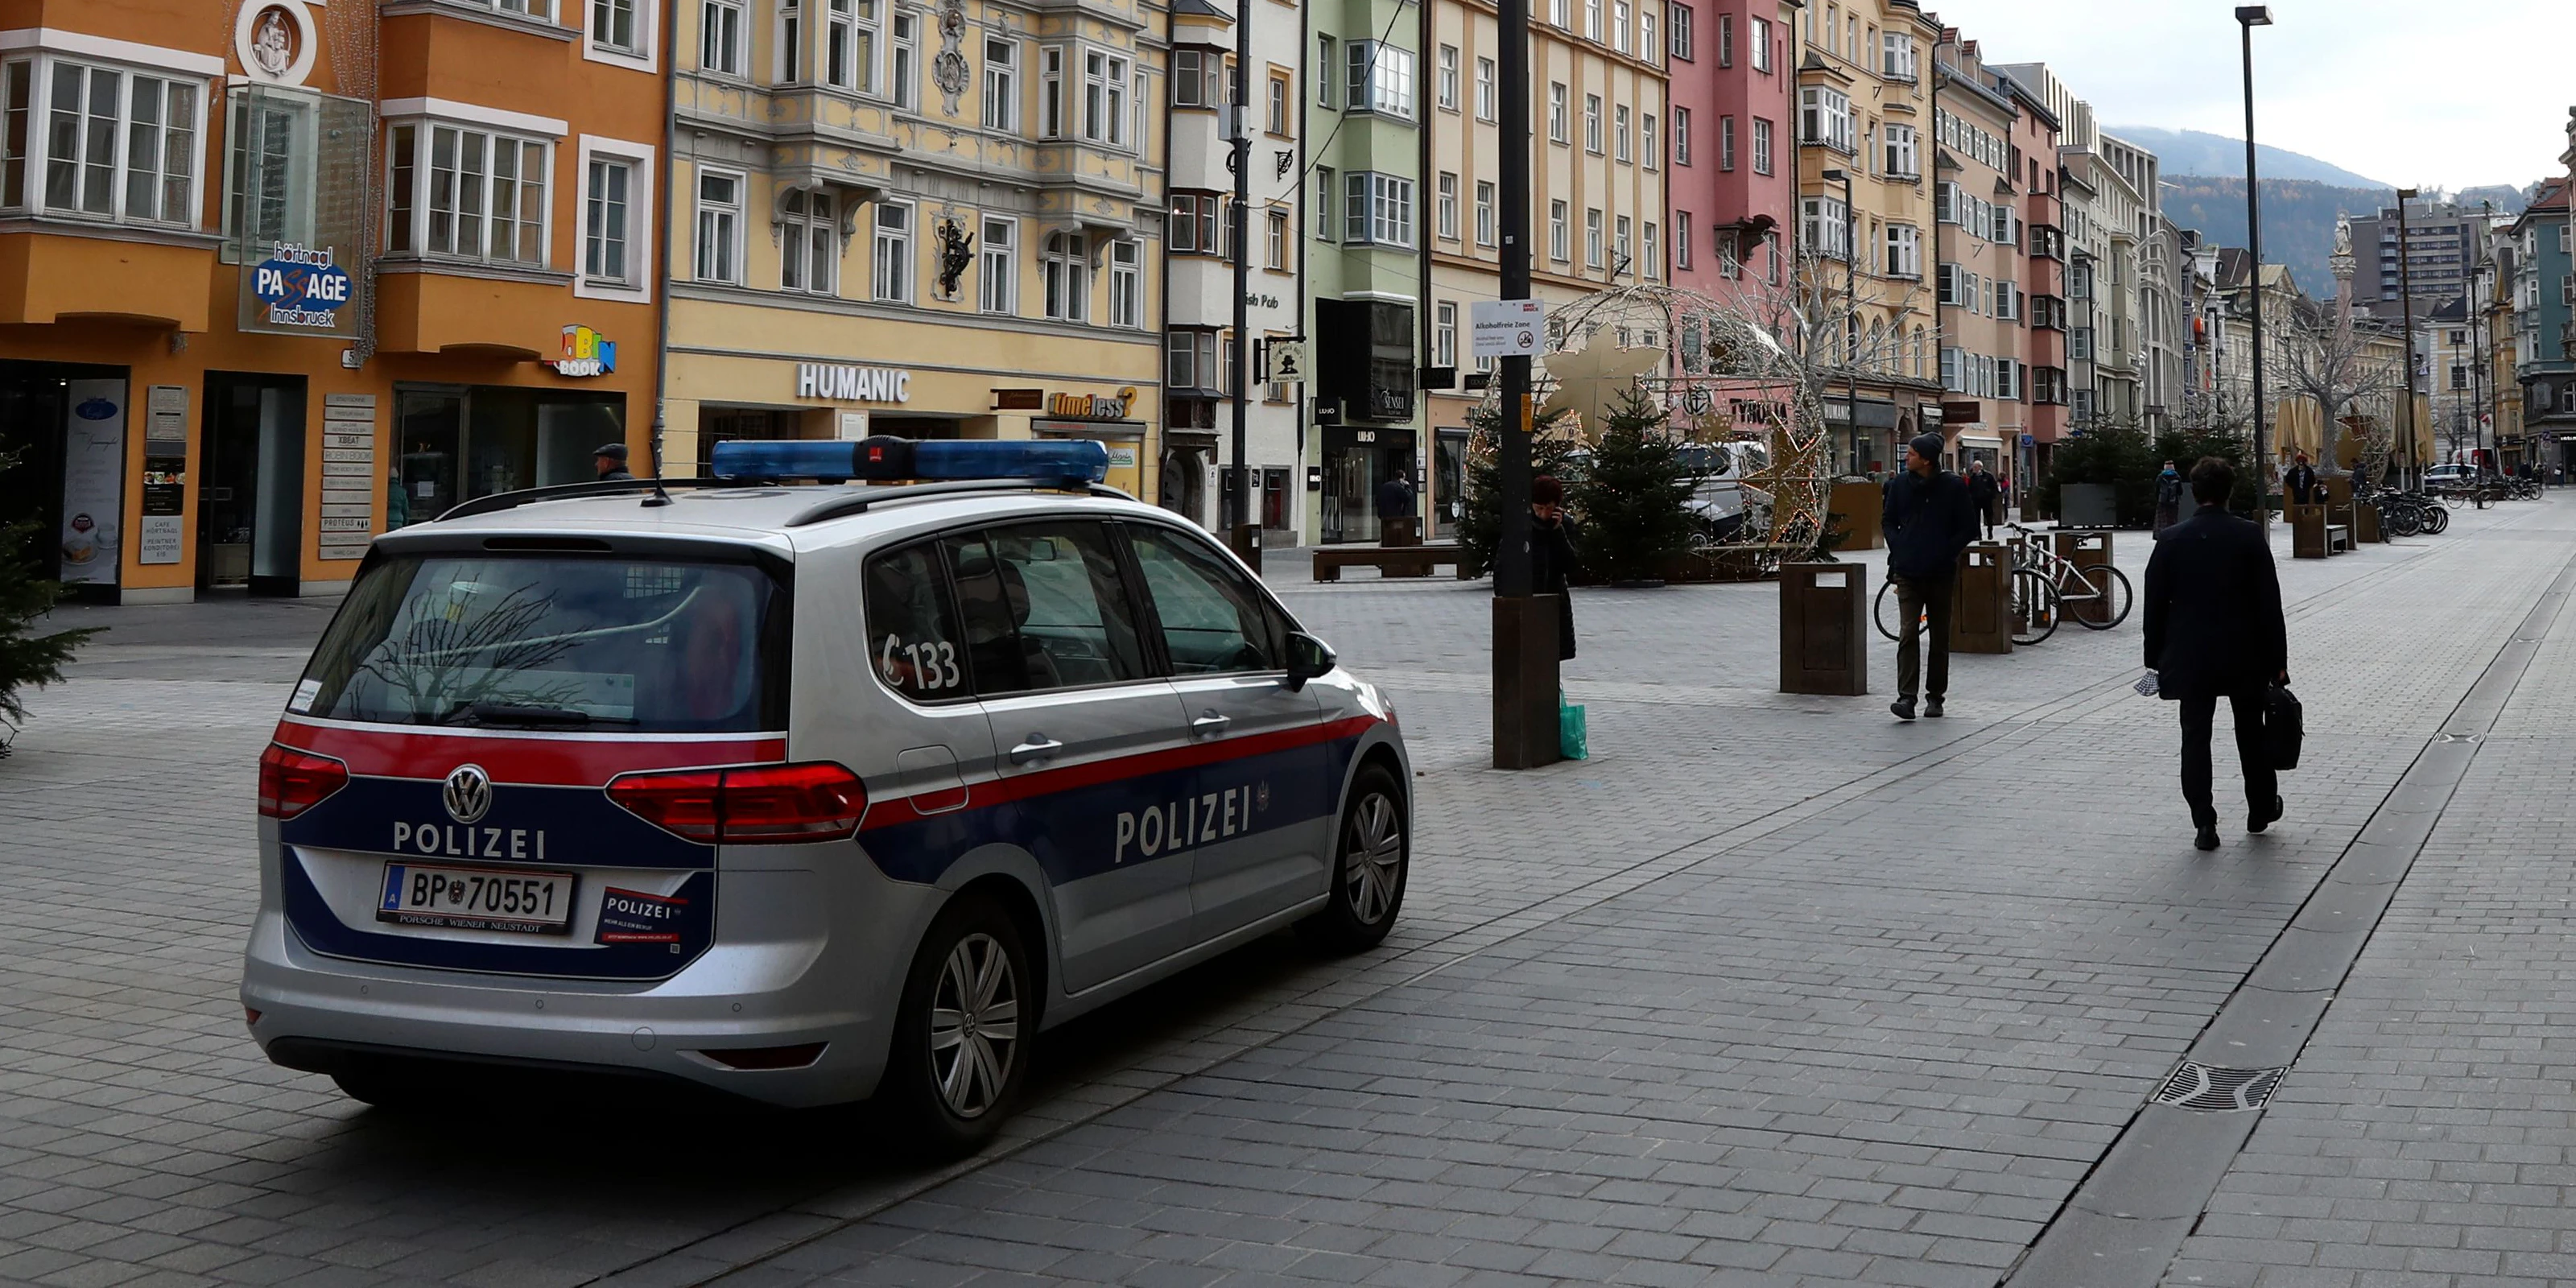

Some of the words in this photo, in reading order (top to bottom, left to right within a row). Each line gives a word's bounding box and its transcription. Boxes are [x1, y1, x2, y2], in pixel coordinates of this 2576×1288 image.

[275, 240, 332, 270] hörtnagl
[270, 303, 335, 328] Innsbruck
[1261, 295, 1279, 309] Pub
[559, 360, 601, 377] BOOK
[797, 363, 910, 402] HUMANIC
[324, 518, 354, 526] PROTEUS
[904, 641, 960, 690] 133
[1115, 785, 1251, 864] POLIZEI
[394, 820, 545, 860] POLIZEI
[387, 894, 397, 903] A
[411, 873, 448, 907] BP
[468, 877, 555, 916] 70551
[607, 898, 671, 919] POLIZEI
[399, 915, 444, 926] PORSCHE
[448, 919, 486, 929] WIENER
[491, 922, 542, 934] NEUSTADT
